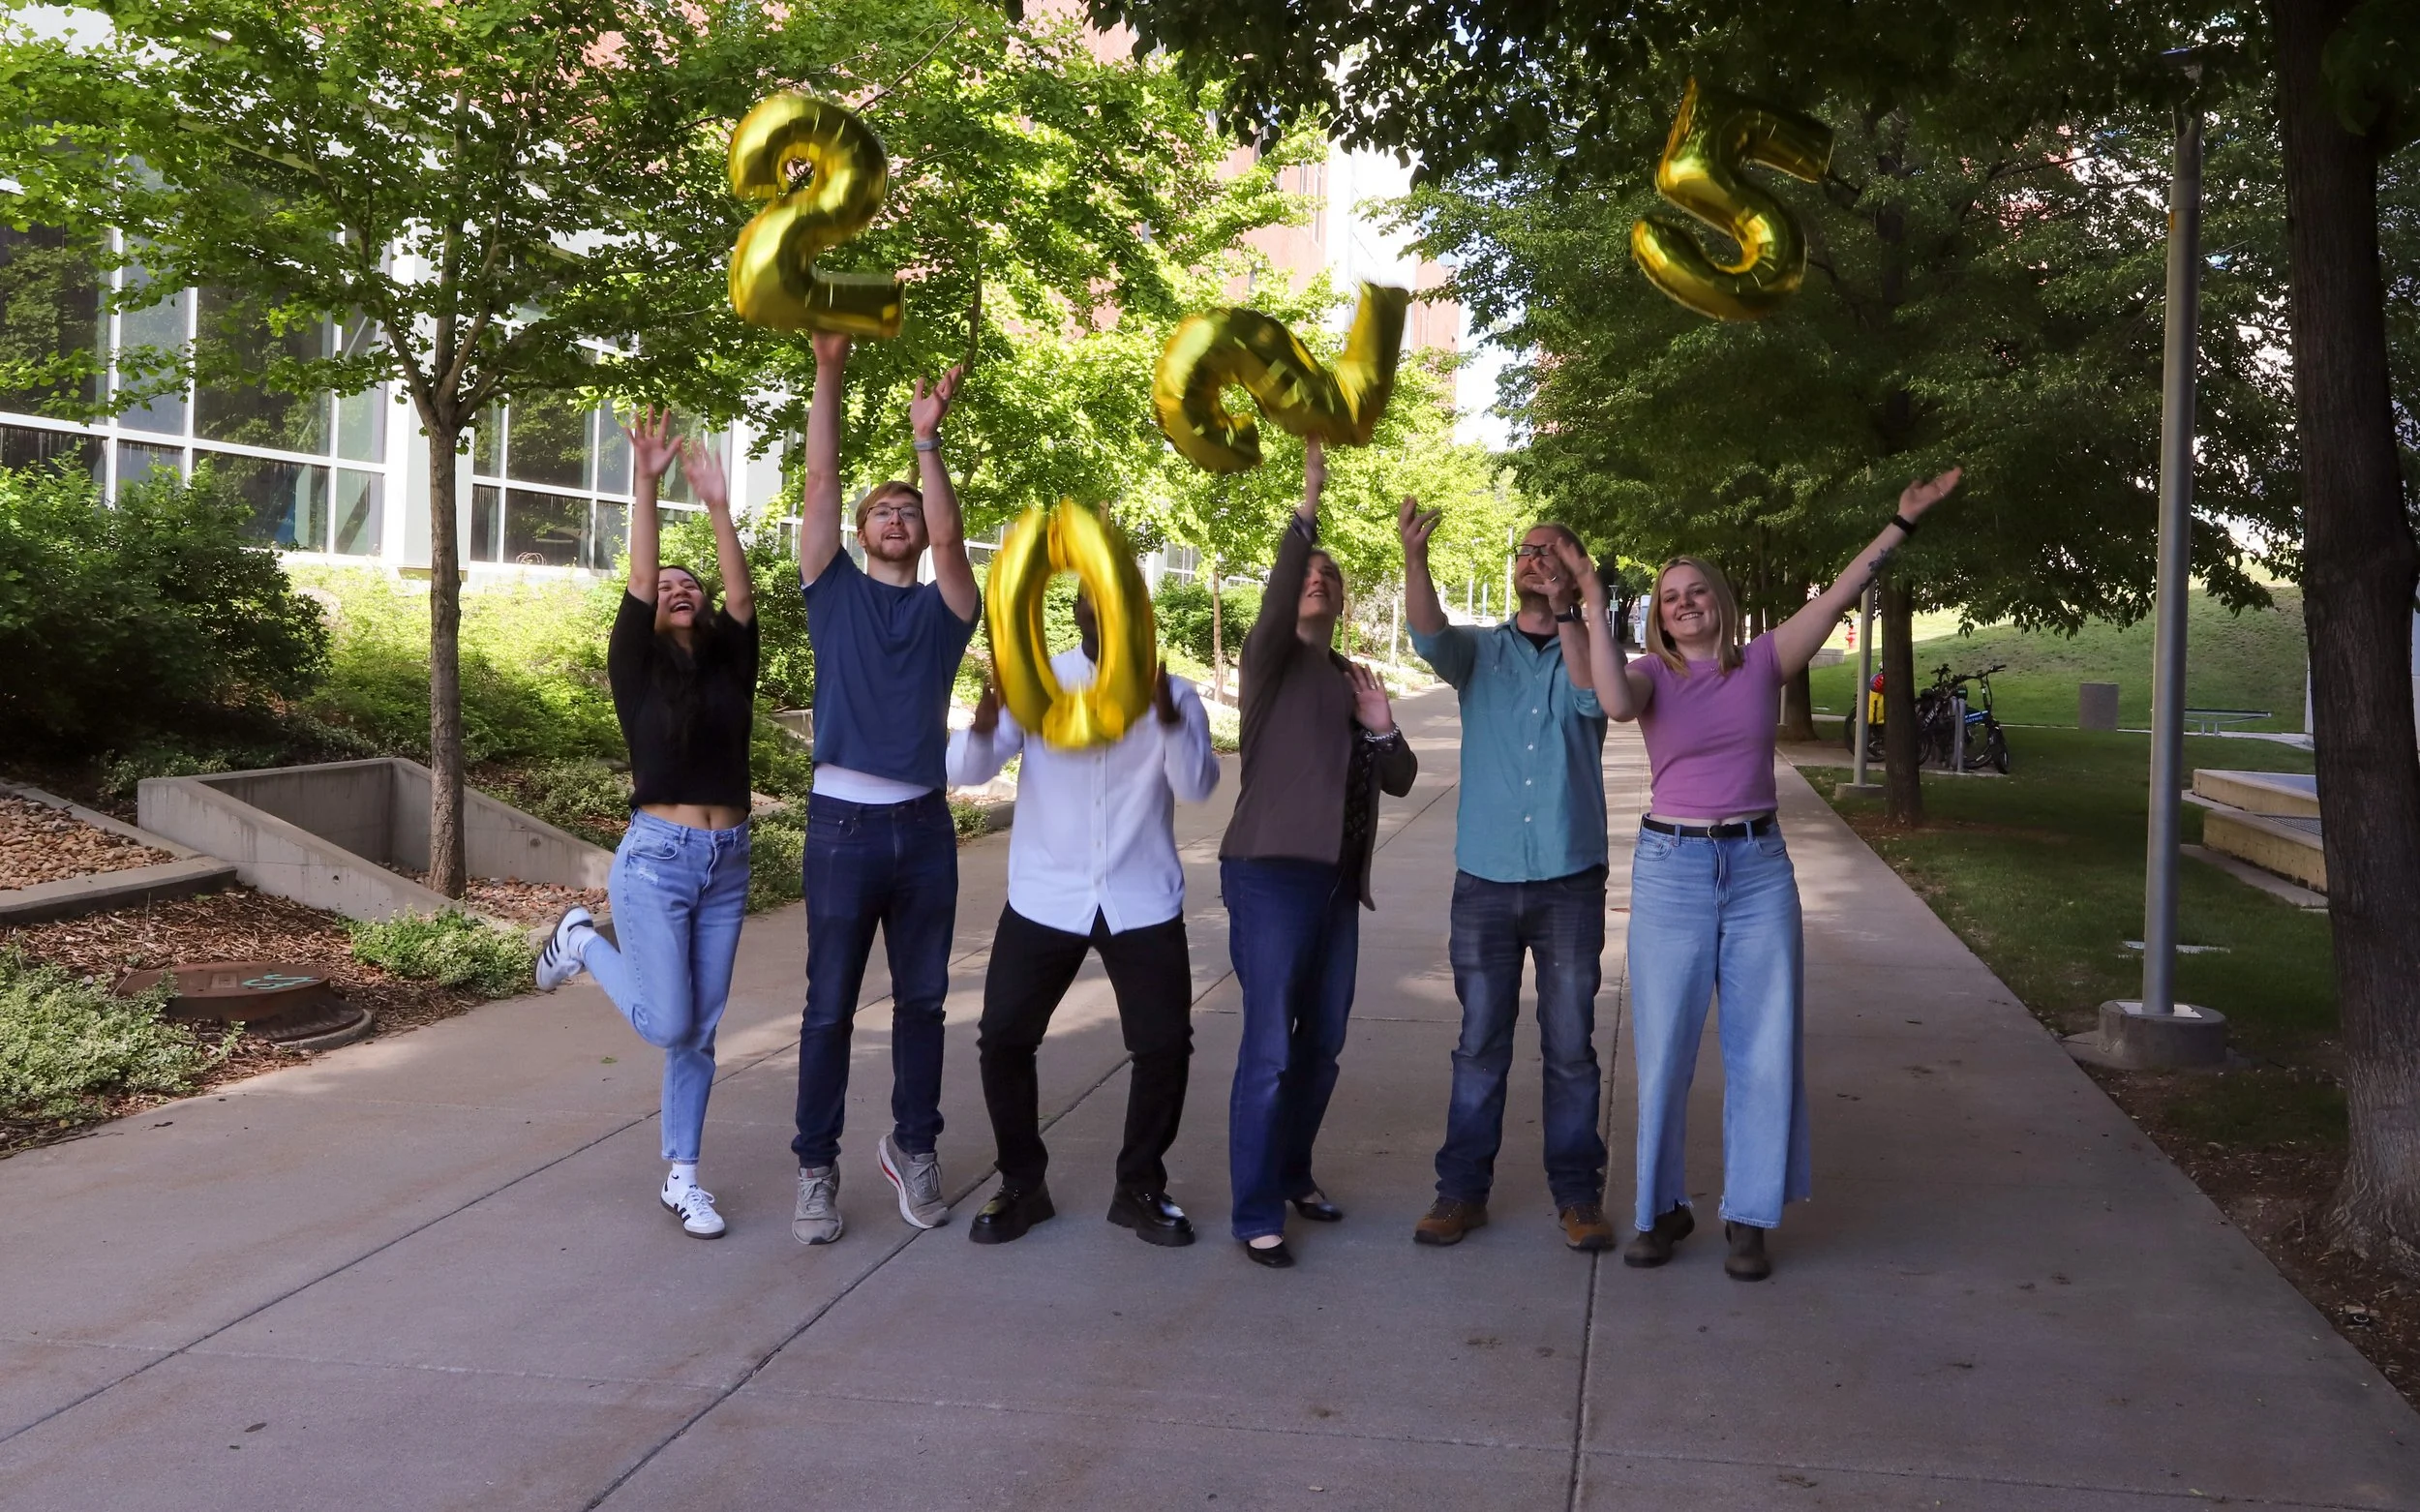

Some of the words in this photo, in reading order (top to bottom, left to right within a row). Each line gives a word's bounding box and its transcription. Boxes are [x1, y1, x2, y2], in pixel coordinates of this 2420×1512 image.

[728, 93, 905, 339] 2
[1631, 76, 1834, 321] 5
[1153, 279, 1408, 473] 2
[984, 498, 1157, 752] 0
